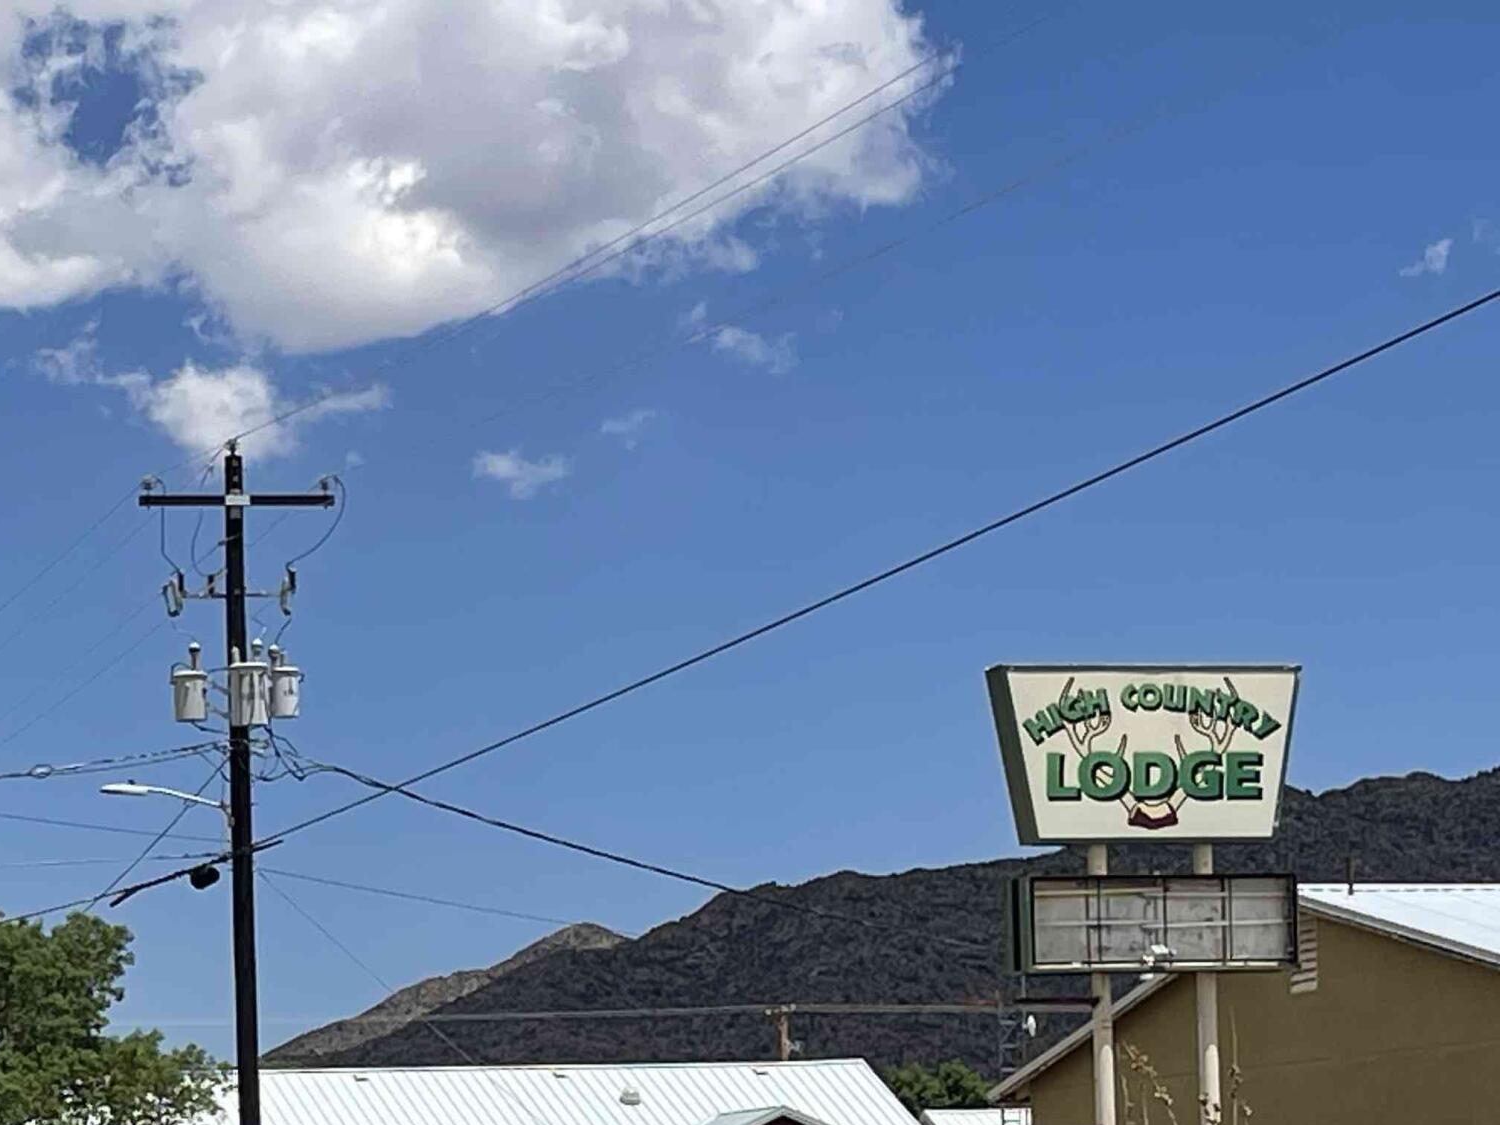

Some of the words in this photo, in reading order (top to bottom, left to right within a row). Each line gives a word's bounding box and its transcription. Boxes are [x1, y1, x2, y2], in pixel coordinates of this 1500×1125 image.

[1022, 688, 1111, 746] HIGH
[1120, 683, 1282, 740] COUNTRY
[1046, 751, 1264, 801] LODGE
